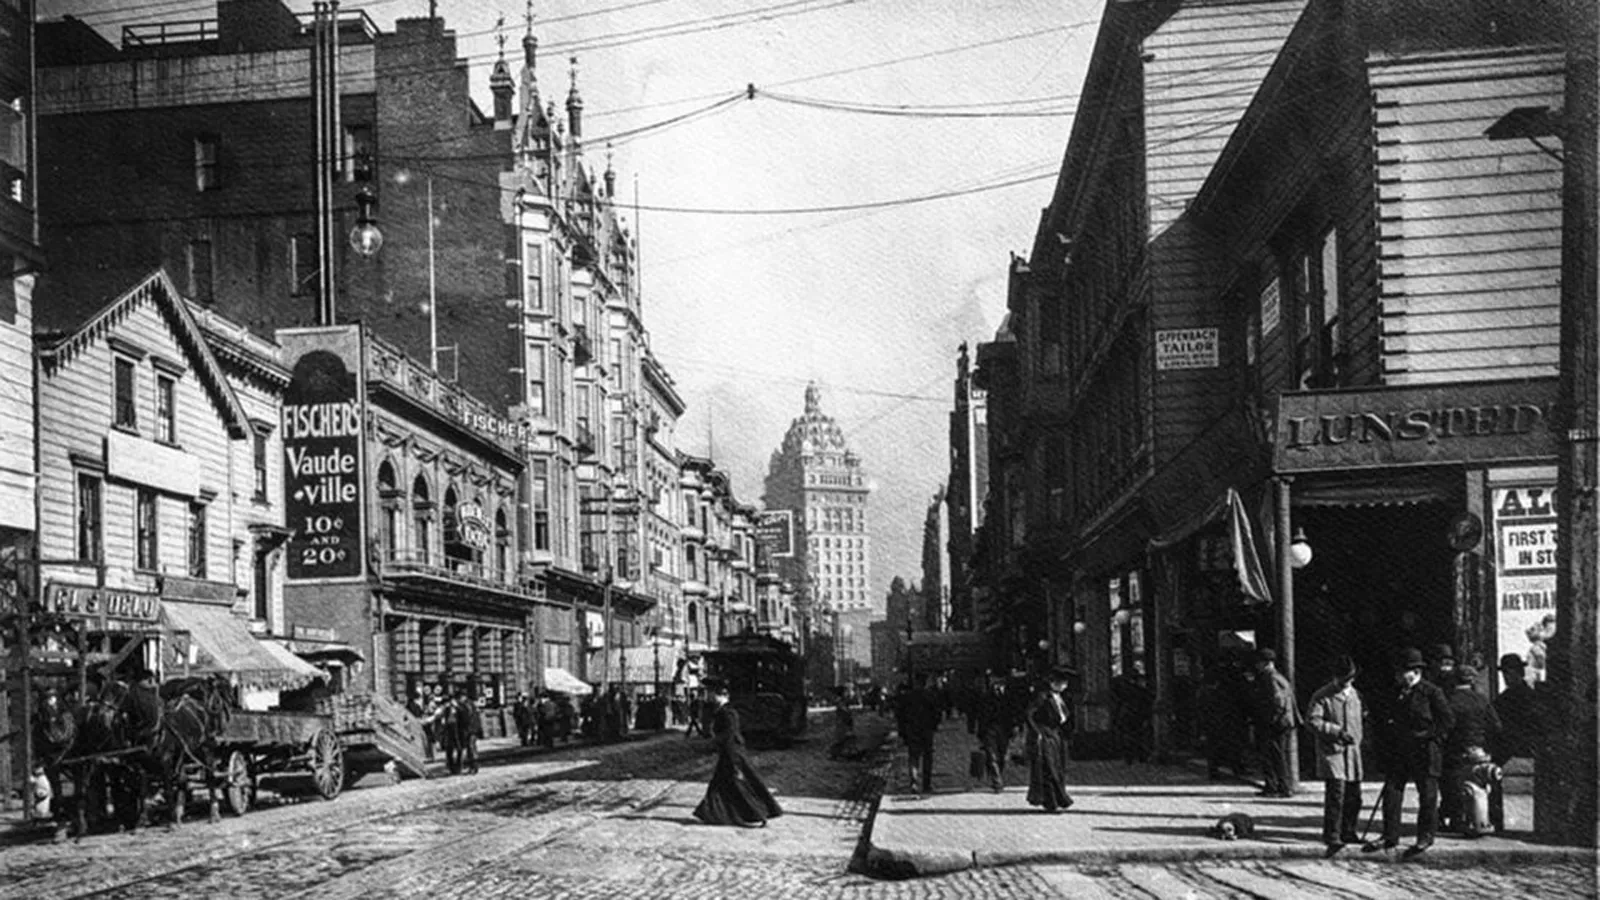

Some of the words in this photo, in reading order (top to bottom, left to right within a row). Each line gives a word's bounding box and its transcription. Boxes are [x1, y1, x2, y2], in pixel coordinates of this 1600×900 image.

[1163, 341, 1214, 353] TAILOR
[282, 398, 362, 438] FISCHER'S
[286, 446, 356, 480] Vaude
[310, 535, 341, 545] AND
[1508, 529, 1546, 546] FIRST
[1518, 549, 1533, 565] IN
